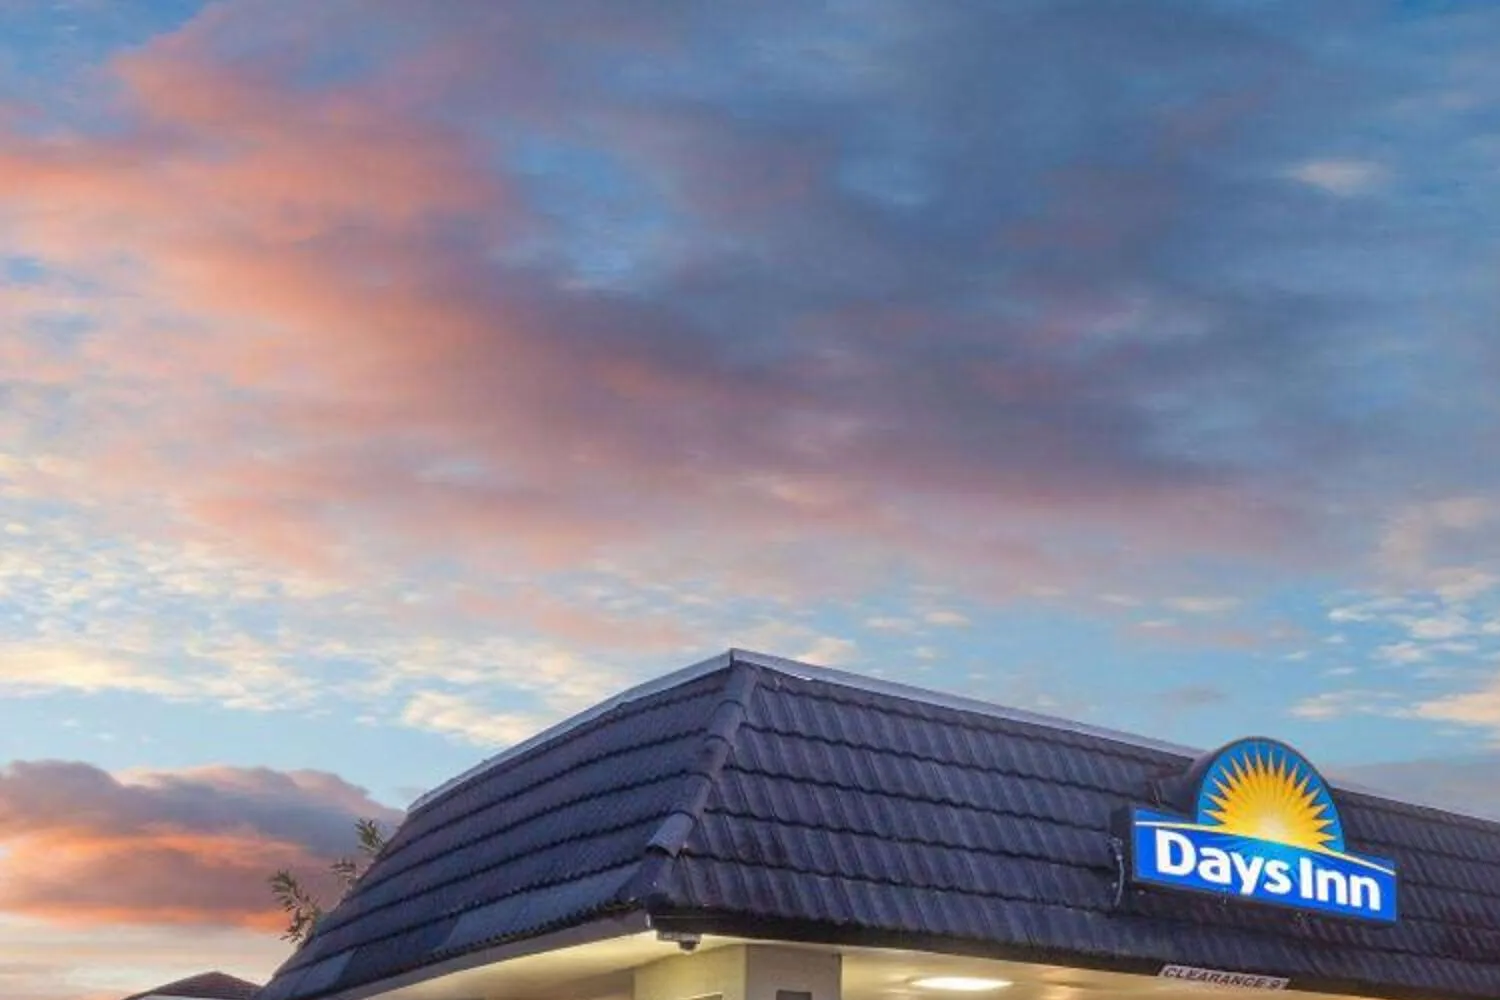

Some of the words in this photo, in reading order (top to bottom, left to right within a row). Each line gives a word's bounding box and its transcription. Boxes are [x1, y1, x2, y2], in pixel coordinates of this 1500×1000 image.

[1155, 828, 1293, 895] Days
[1299, 856, 1381, 912] Inn
[1163, 966, 1267, 989] CLEARANCE
